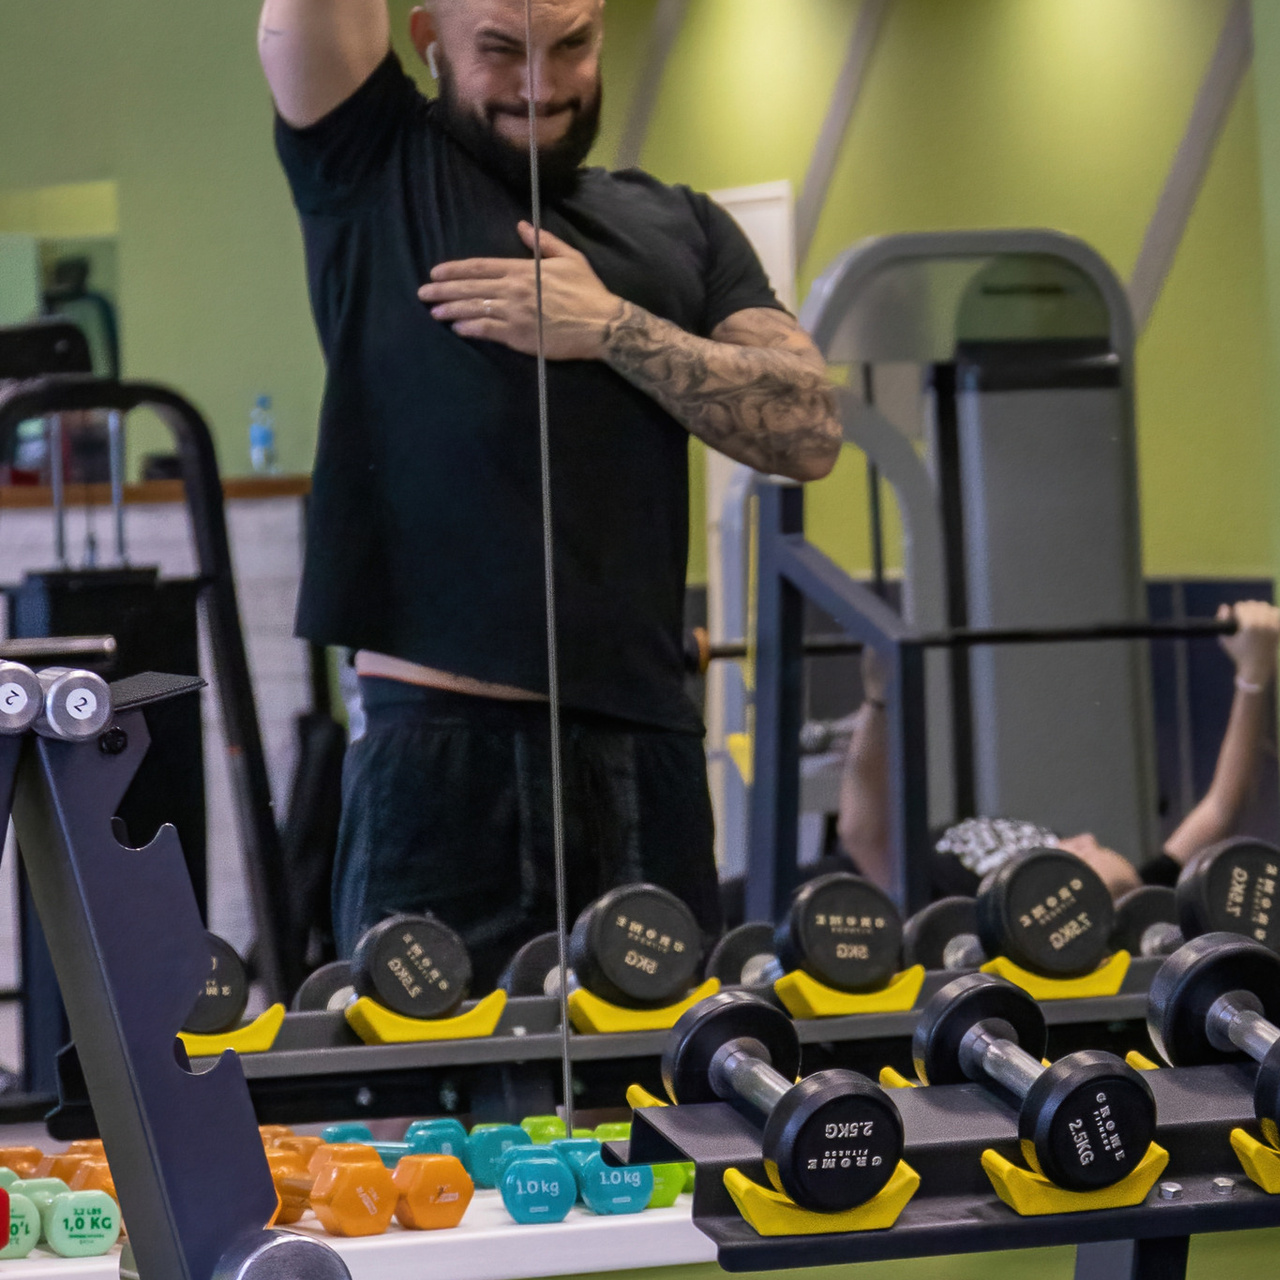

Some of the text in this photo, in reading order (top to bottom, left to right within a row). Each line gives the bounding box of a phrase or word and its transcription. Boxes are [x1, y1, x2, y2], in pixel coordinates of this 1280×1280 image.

[5, 689, 20, 706] 2
[73, 696, 88, 712] 2
[825, 1121, 874, 1139] 2.5KG
[1095, 1092, 1126, 1161] GROME
[1068, 1118, 1095, 1166] 2.5KG
[824, 1149, 869, 1157] FITNESS
[807, 1156, 883, 1170] GROME
[623, 1171, 642, 1188] kg
[541, 1180, 560, 1197] kg
[63, 1217, 112, 1232] 1,0 KG
